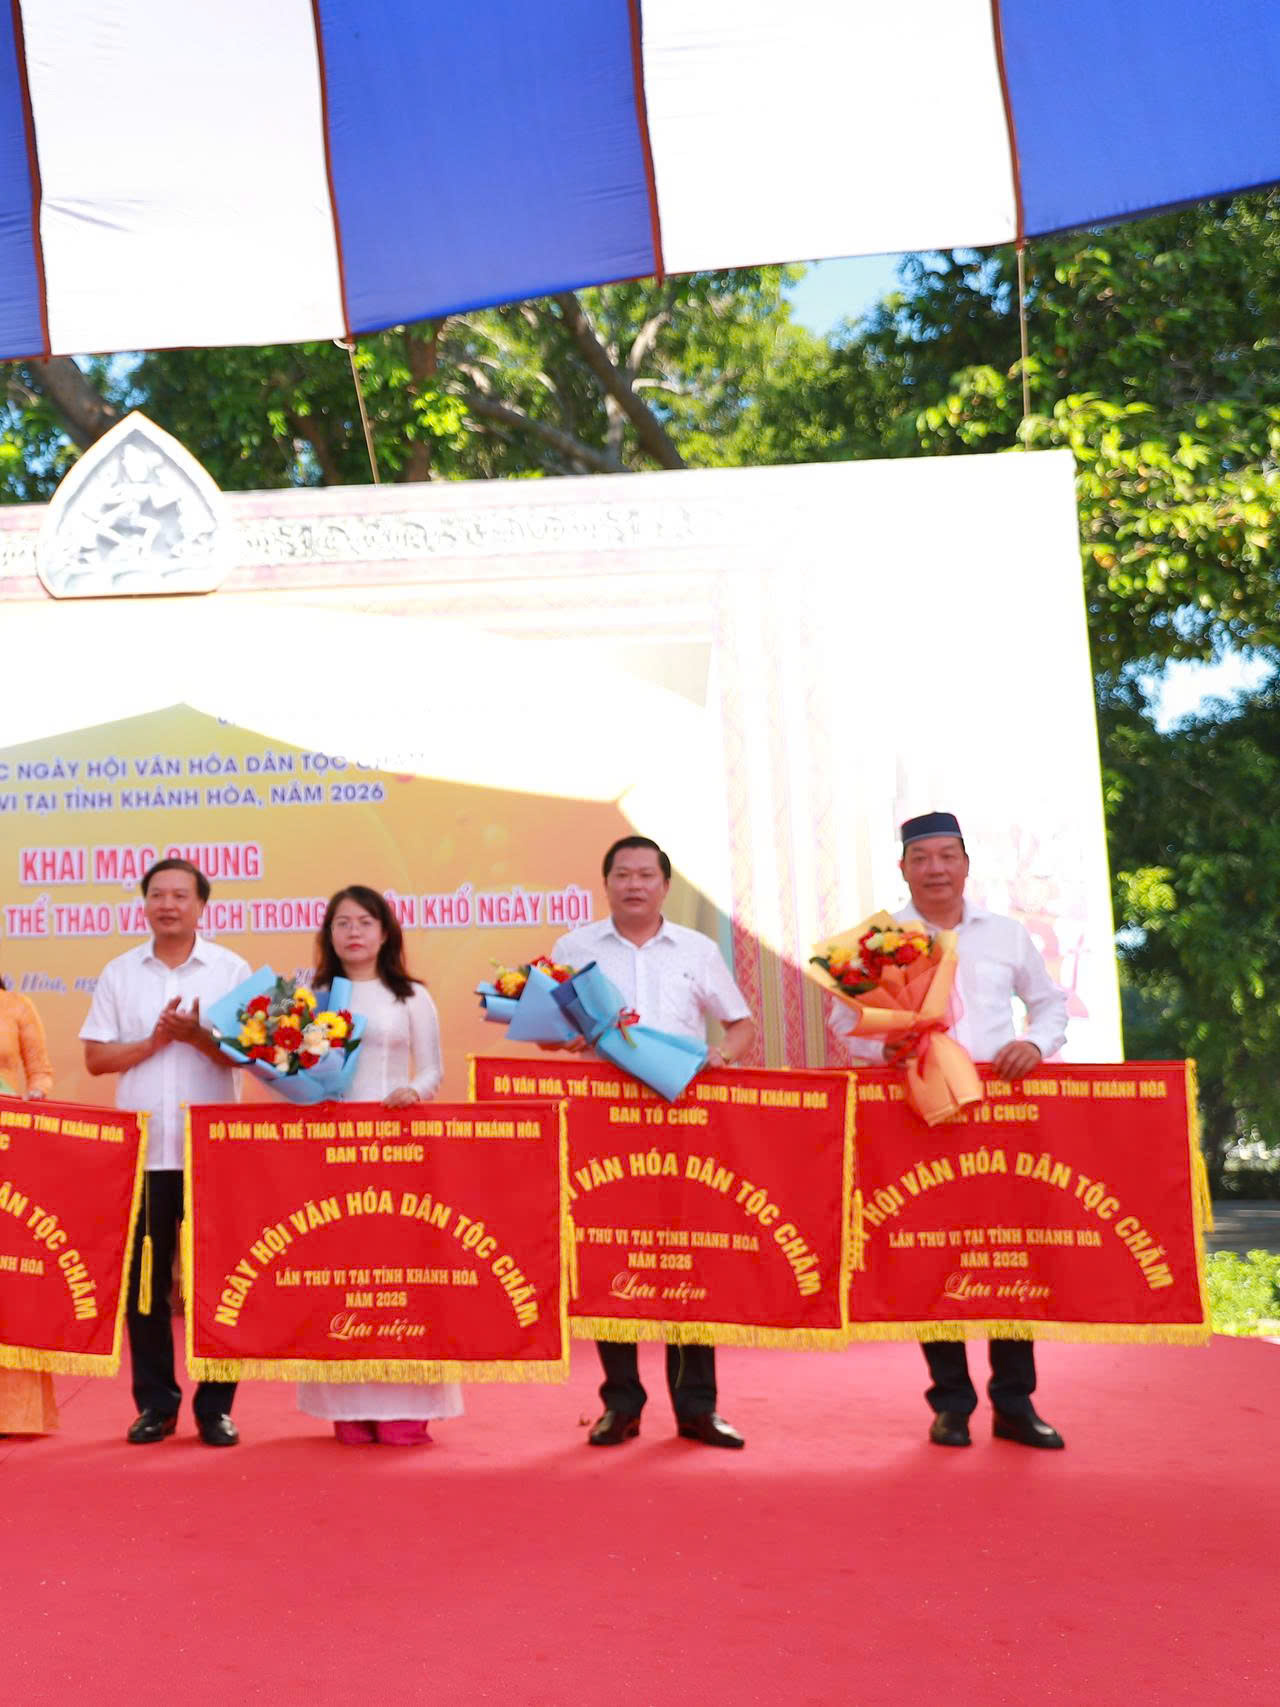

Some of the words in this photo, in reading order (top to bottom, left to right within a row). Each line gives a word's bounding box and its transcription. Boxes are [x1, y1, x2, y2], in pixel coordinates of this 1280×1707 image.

[18, 757, 80, 779] NGÀY
[87, 755, 127, 784] HỘI
[135, 756, 181, 776] VĂN
[188, 753, 238, 774] HÓA
[246, 750, 294, 772] DÂN
[24, 793, 57, 815] TẠI
[64, 785, 113, 810] TỈNH
[121, 786, 198, 809] KHÁNH
[206, 783, 264, 807] HÒA,
[271, 782, 322, 803] NĂM
[330, 784, 385, 802] 2026
[22, 850, 85, 882] KHAI
[6, 896, 47, 934] THỂ
[54, 907, 111, 933] THAO
[423, 886, 470, 925] KHỔ
[478, 893, 543, 922] NGÀY
[551, 891, 590, 926] HỘI
[325, 1145, 358, 1164] BAN
[575, 1157, 625, 1193] VĂN
[628, 1147, 679, 1178] HÓA
[684, 1154, 736, 1194] DÂN
[734, 1179, 781, 1227] TỘC
[773, 1221, 821, 1298] CHĂM
[900, 1161, 955, 1198] VĂN
[959, 1145, 1008, 1178] HÓA
[1014, 1153, 1073, 1190] DÂN
[1072, 1174, 1121, 1222] TỘC
[1113, 1215, 1175, 1291] CHĂM
[26, 1204, 69, 1252] TỘC
[57, 1247, 99, 1321] CHĂM
[214, 1258, 259, 1328] NGÀY
[249, 1222, 294, 1266] HỘI
[289, 1197, 342, 1235] VĂN
[346, 1185, 395, 1217] HÓA
[399, 1192, 452, 1230] DÂN
[453, 1213, 498, 1261] TỘC
[491, 1253, 540, 1329] CHĂM
